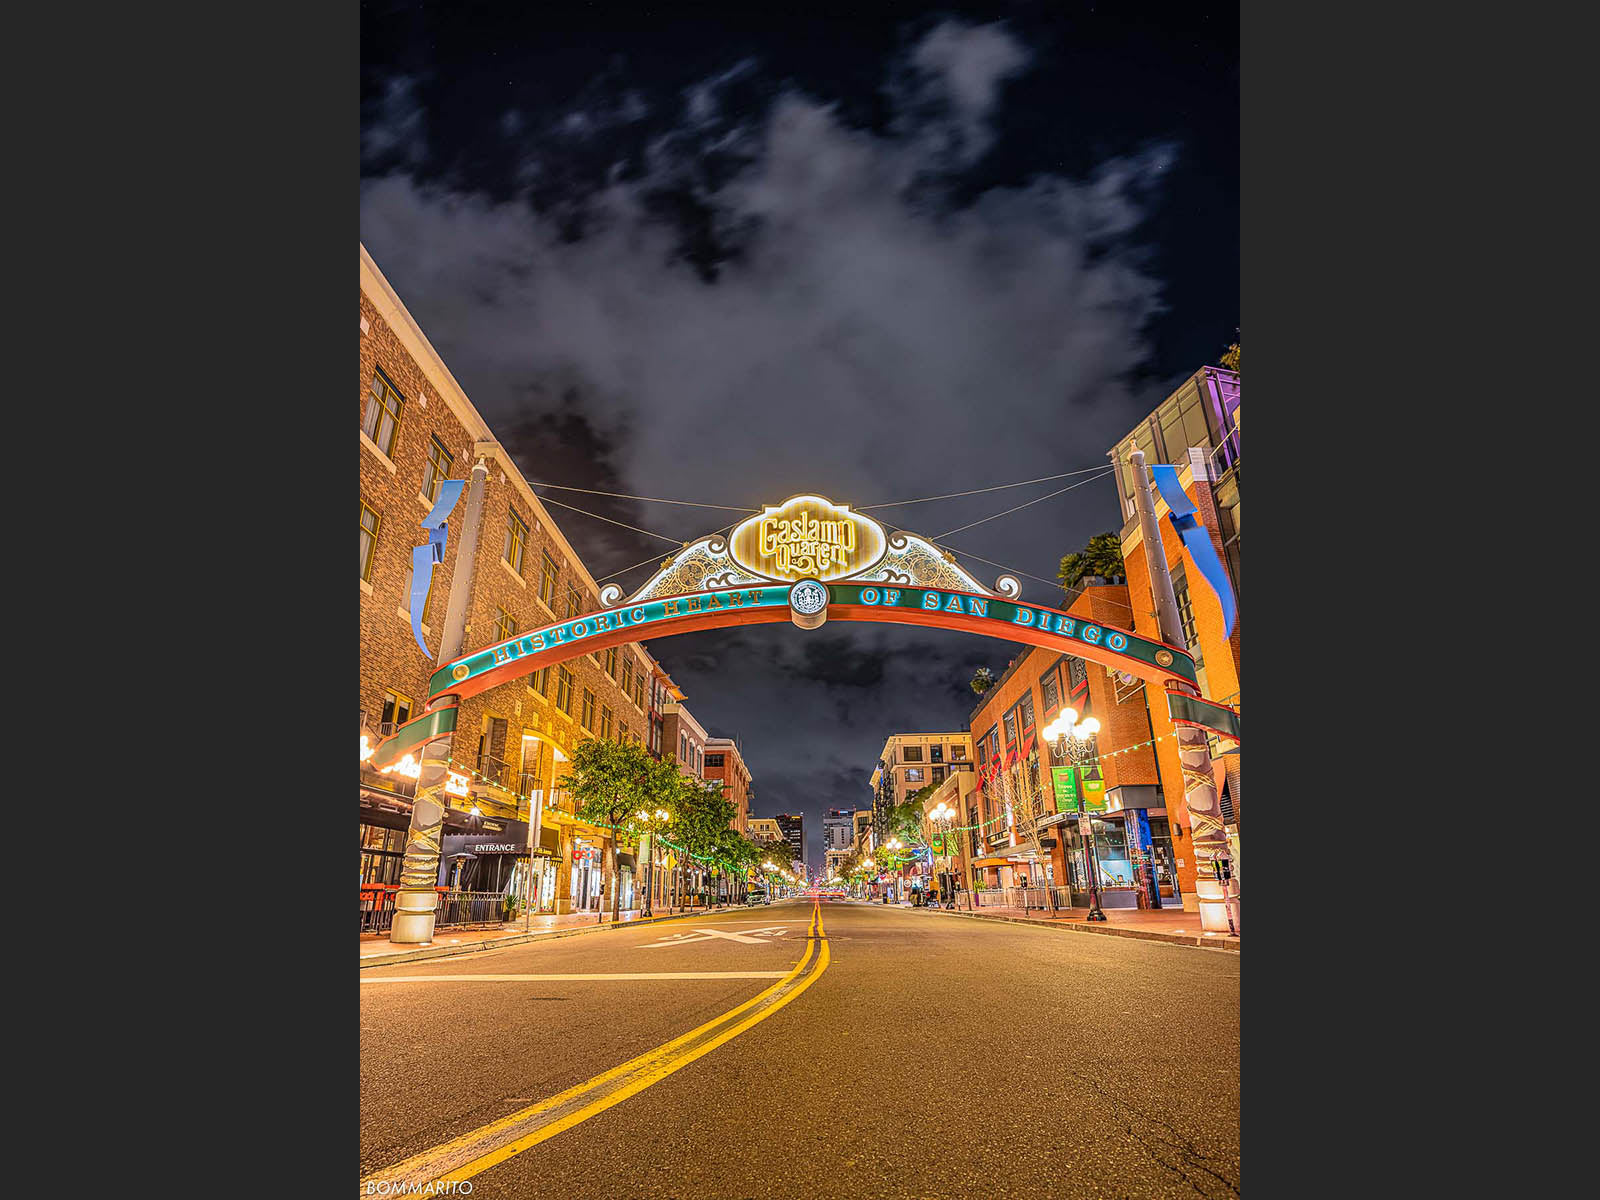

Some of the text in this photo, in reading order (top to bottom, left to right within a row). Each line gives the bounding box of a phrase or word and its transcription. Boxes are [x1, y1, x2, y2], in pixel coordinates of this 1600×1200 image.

[759, 511, 855, 557] Gaslamp
[775, 540, 848, 575] Quarter
[491, 605, 646, 665] HISTORIC
[663, 589, 765, 617] HEART
[862, 588, 901, 605] OF
[924, 592, 989, 617] SAN
[1015, 607, 1128, 652] DIEGO
[475, 844, 515, 852] ENTRANCE
